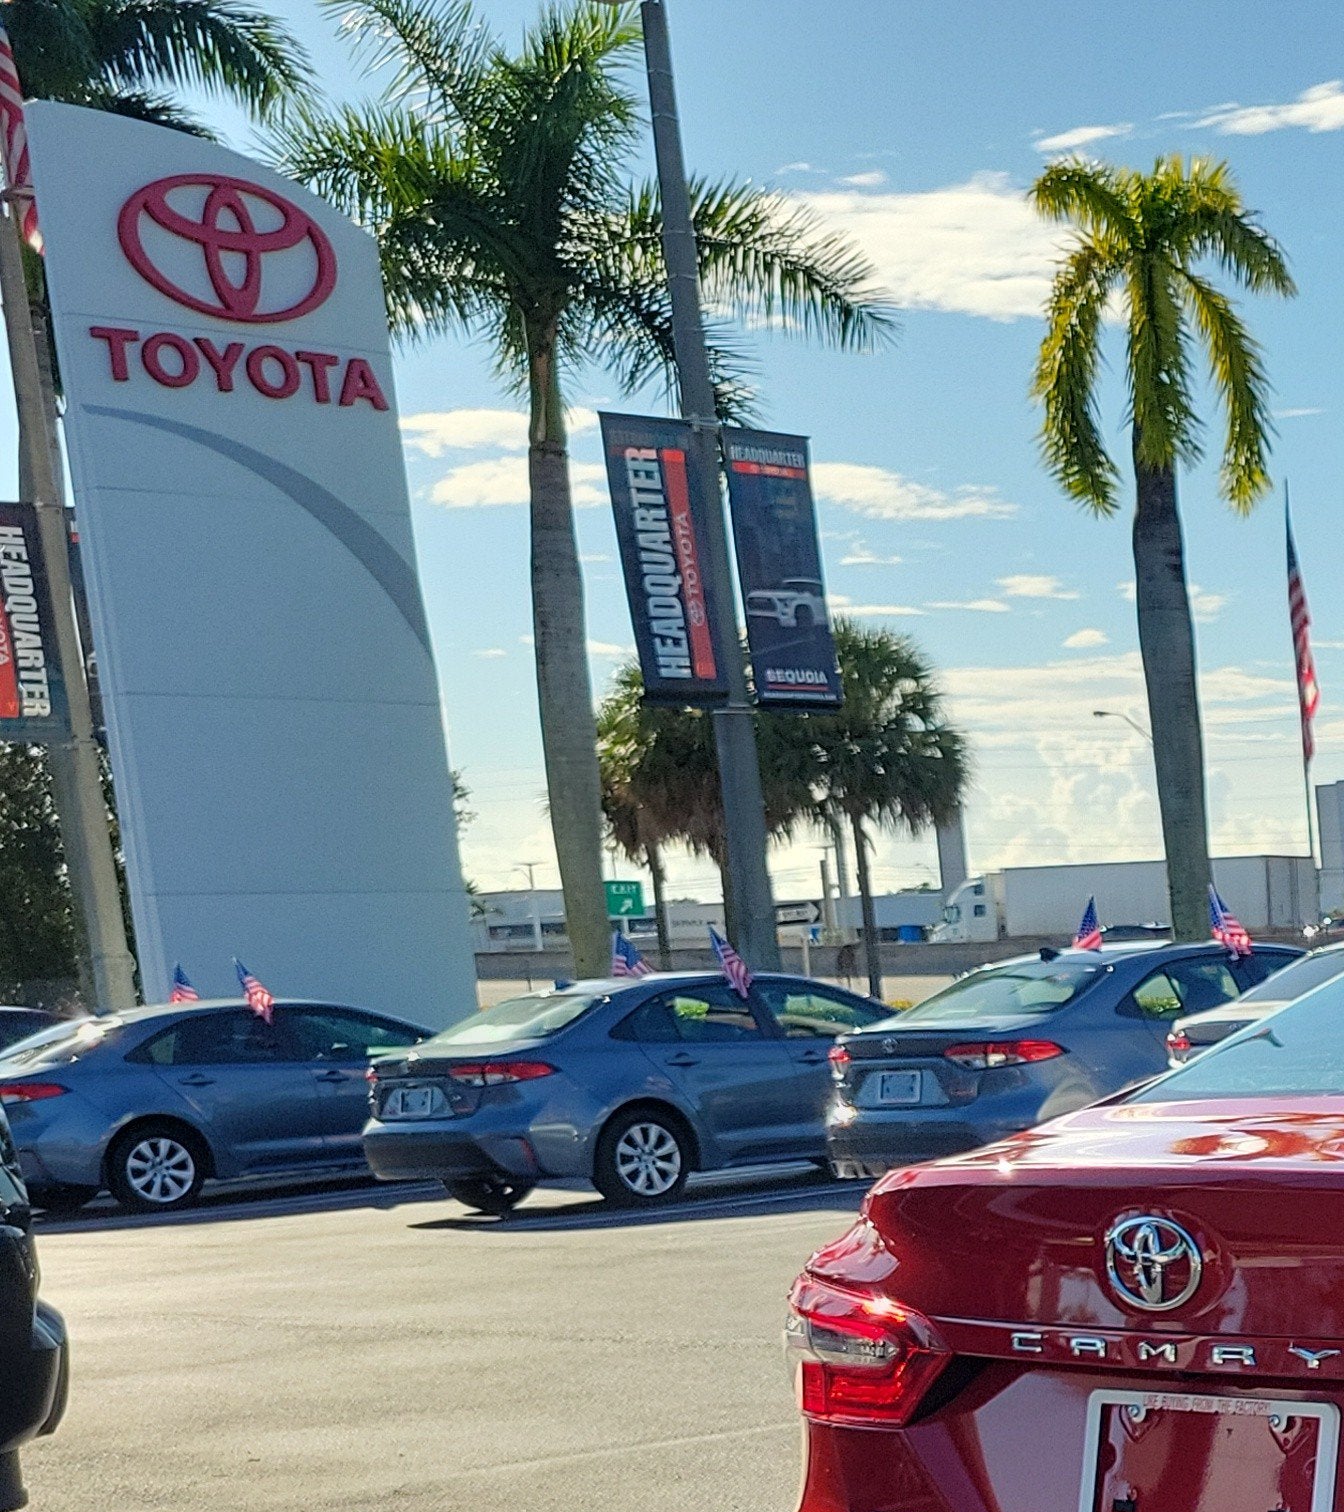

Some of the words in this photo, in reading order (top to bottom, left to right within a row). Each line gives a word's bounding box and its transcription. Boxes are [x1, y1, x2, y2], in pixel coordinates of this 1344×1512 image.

[89, 326, 390, 411] TOYOTA
[624, 447, 692, 679] HEADQUARTER
[673, 512, 703, 599] TOYOTA
[0, 526, 51, 717] HEADQUARTER
[766, 668, 828, 684] SEQUOIA
[1012, 1333, 1341, 1369] CAMRY
